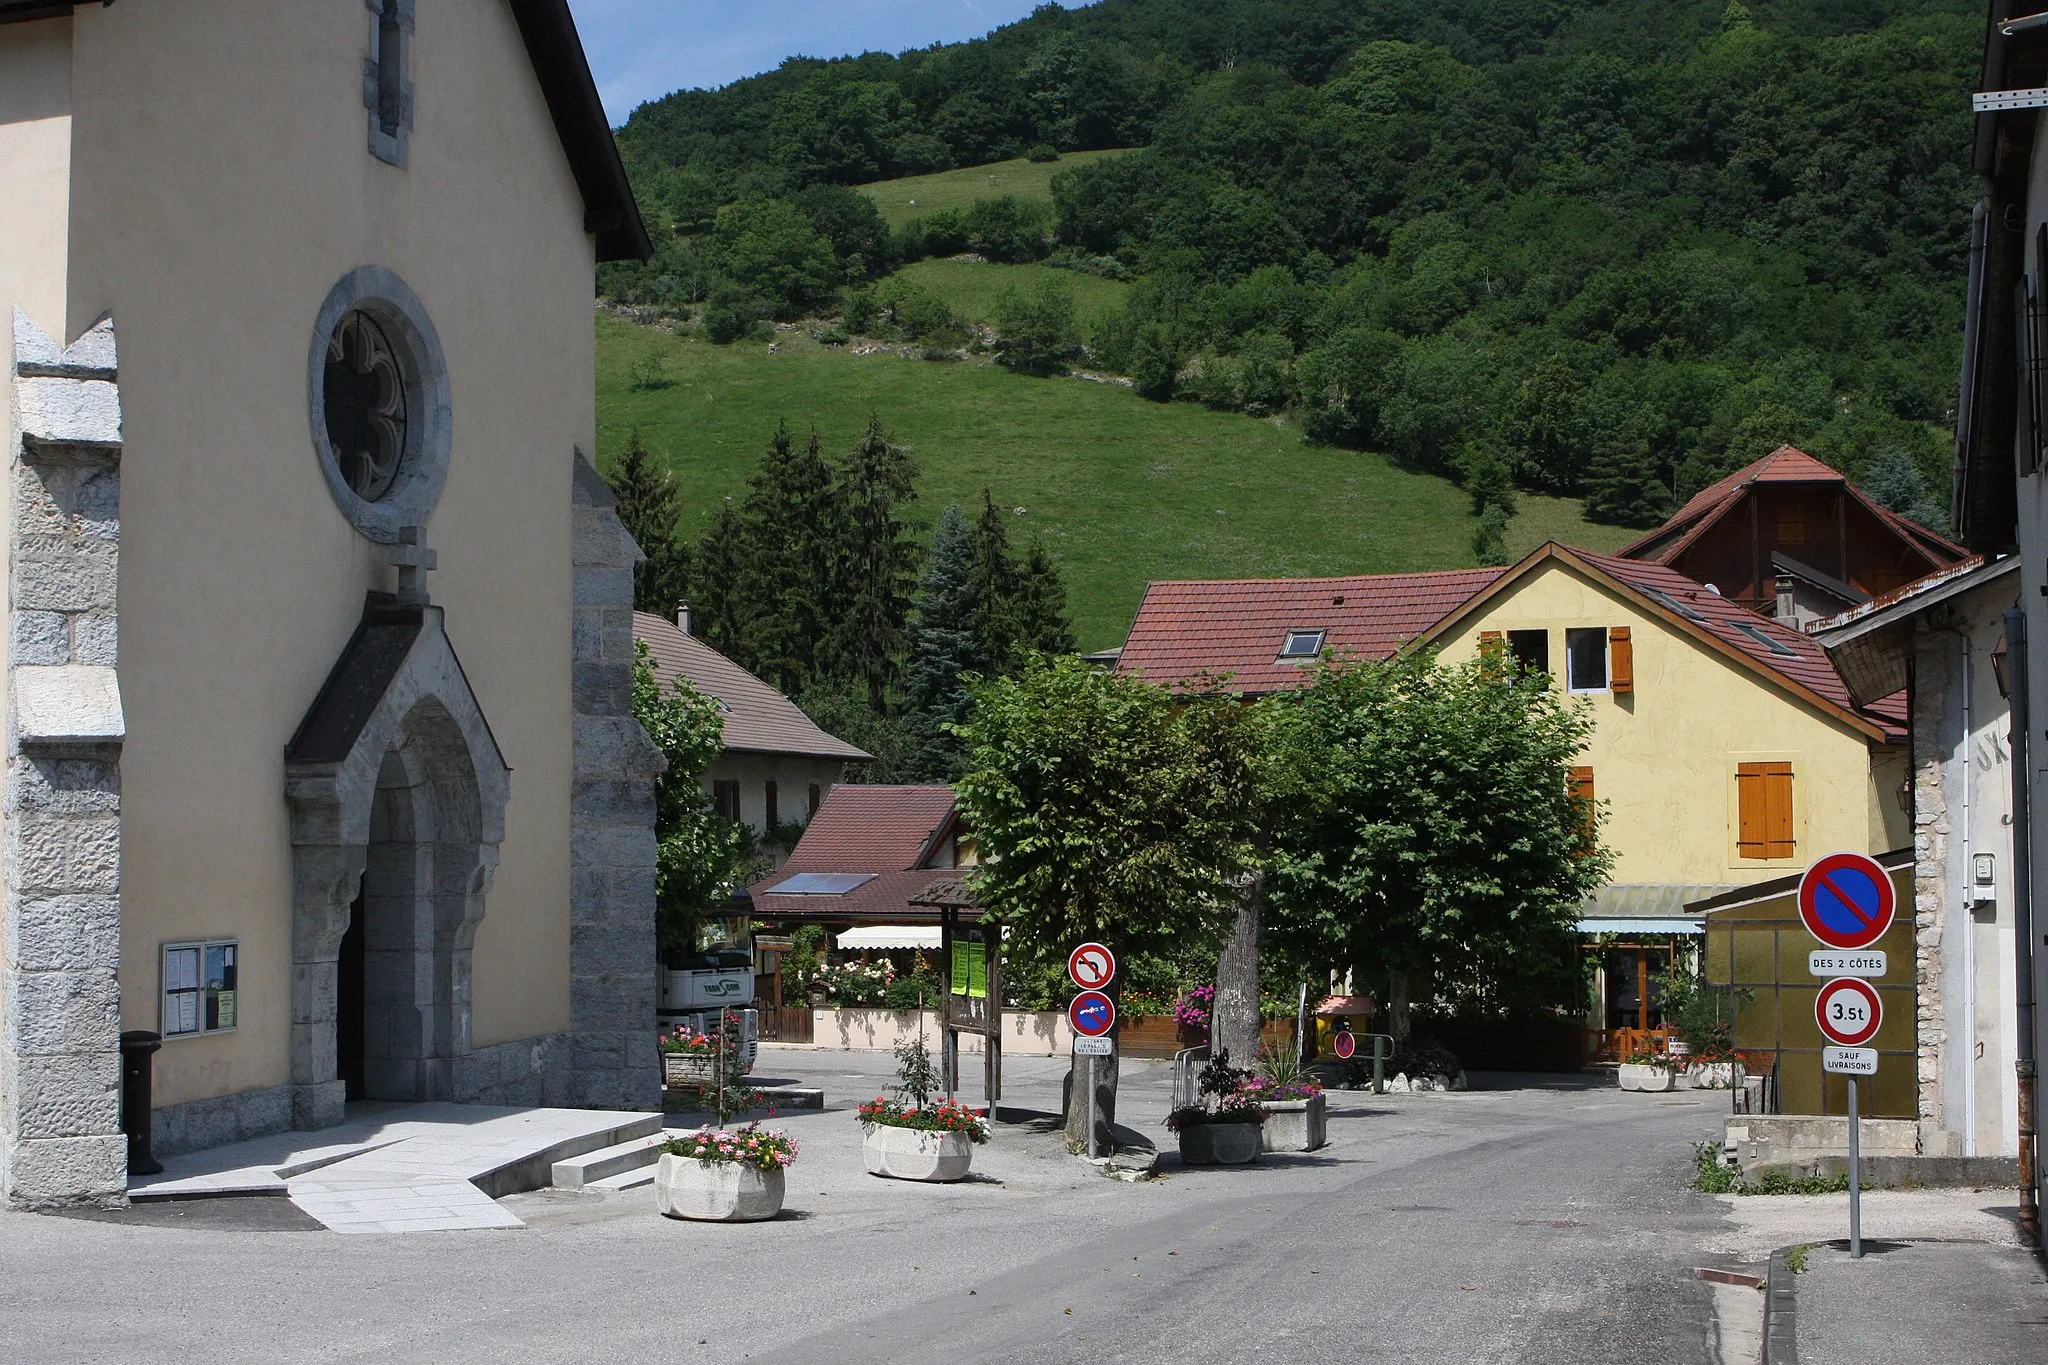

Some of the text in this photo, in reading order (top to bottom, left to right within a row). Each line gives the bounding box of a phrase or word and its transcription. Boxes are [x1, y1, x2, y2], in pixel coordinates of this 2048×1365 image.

[1813, 957, 1882, 968] DES 2 CÔTÉS
[1838, 1052, 1860, 1060] SAUF
[1827, 1061, 1872, 1071] LIVRAISONS
